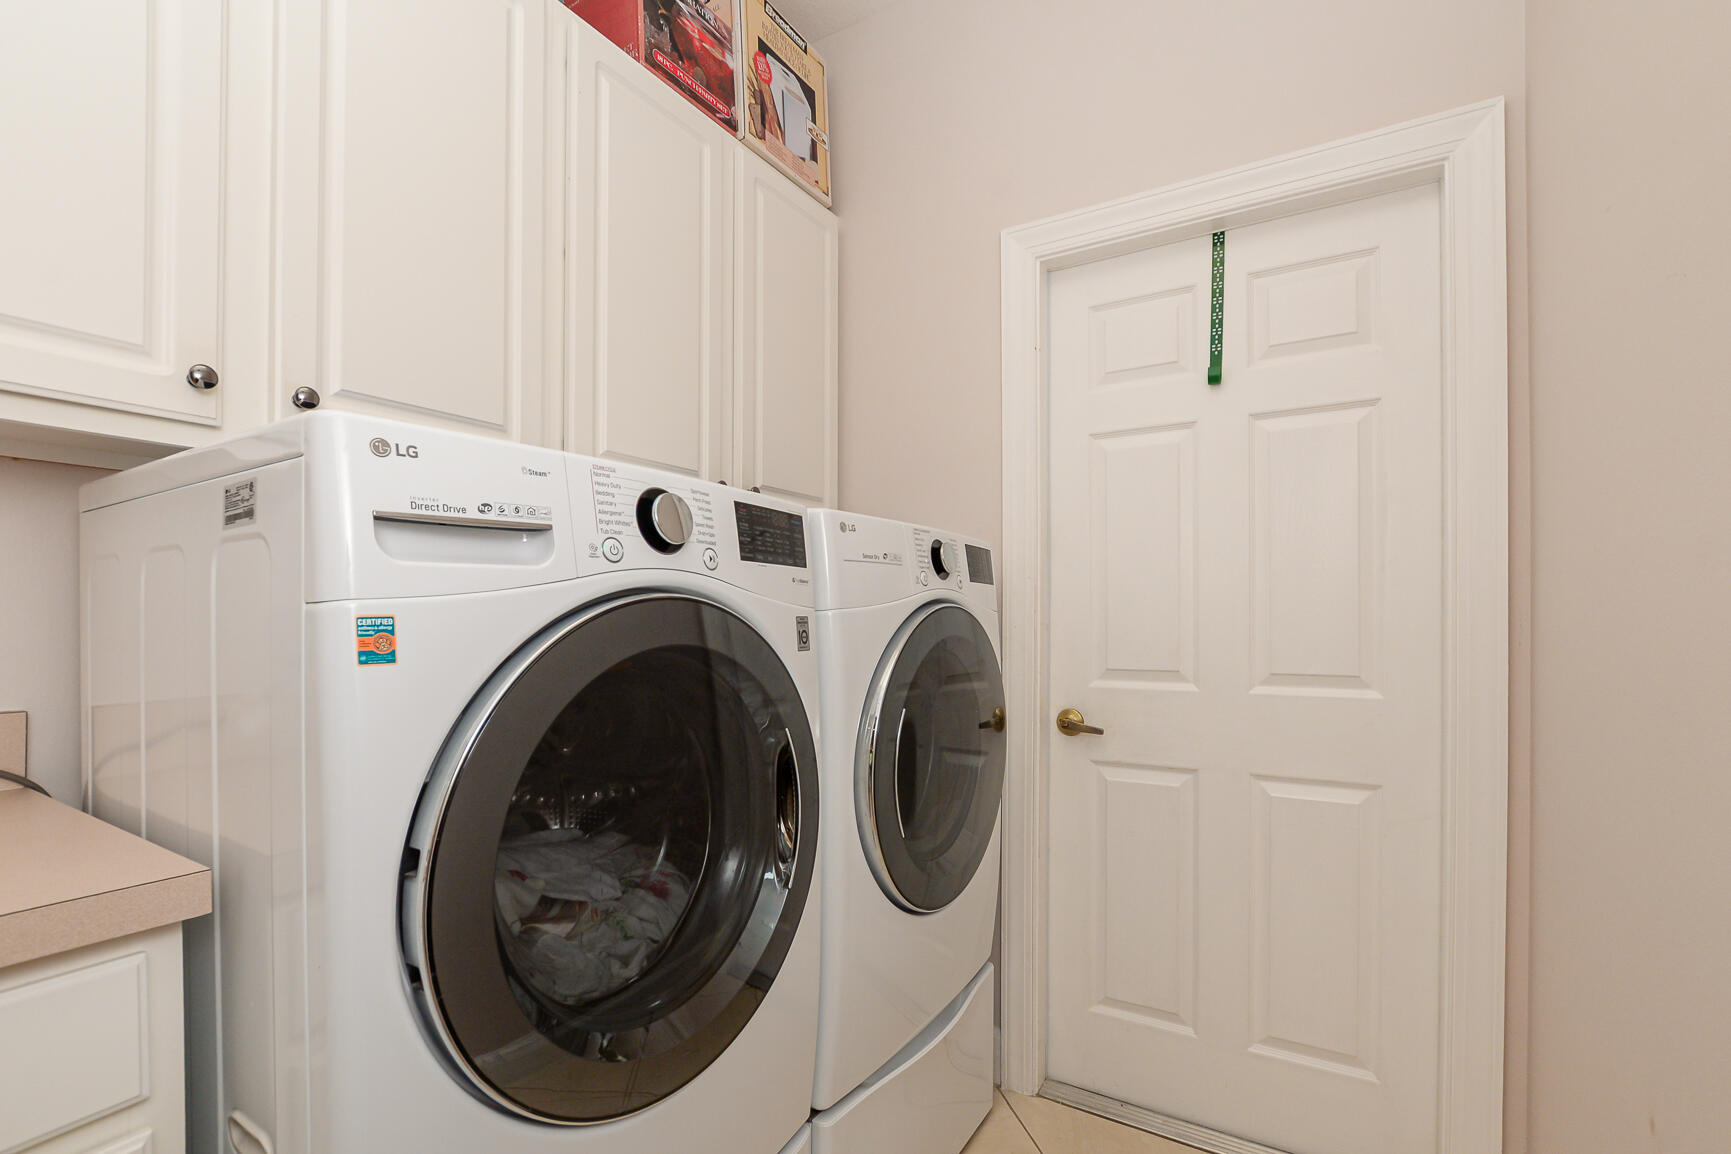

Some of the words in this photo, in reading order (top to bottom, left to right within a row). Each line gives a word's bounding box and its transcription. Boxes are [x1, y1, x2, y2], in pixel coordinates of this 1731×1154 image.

[395, 443, 419, 459] LG
[410, 501, 440, 512] Direct
[442, 503, 467, 514] Drive
[847, 524, 856, 532] LG
[357, 618, 393, 626] CERTIFIED
